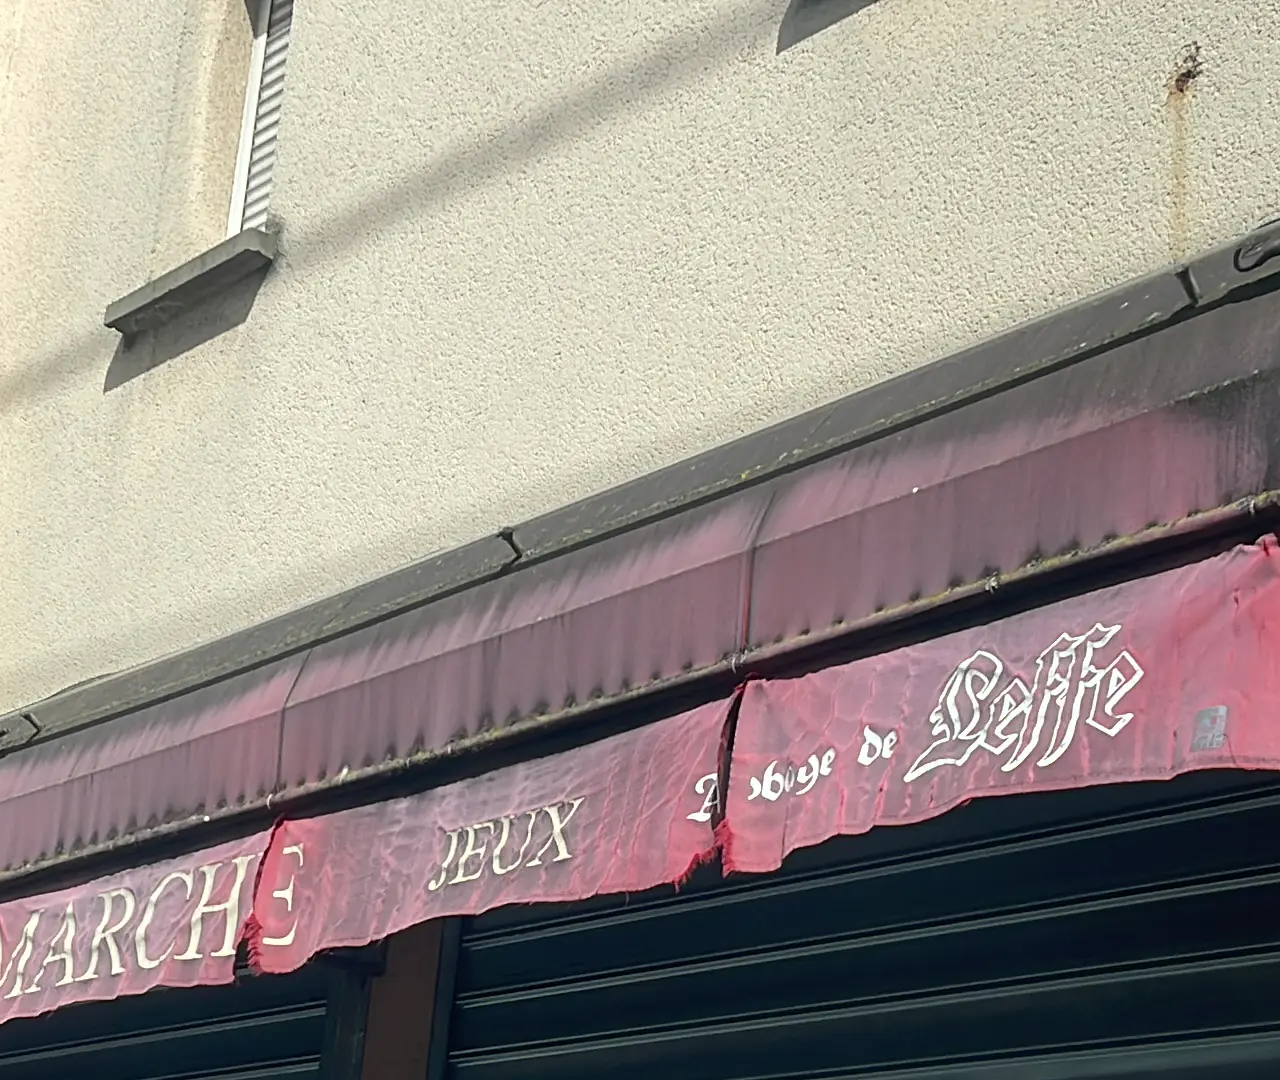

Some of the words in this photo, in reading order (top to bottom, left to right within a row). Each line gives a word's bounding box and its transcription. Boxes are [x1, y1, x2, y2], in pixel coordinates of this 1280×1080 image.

[857, 725, 898, 766] de
[903, 622, 1144, 783] Leffe
[428, 797, 585, 890] JEUX
